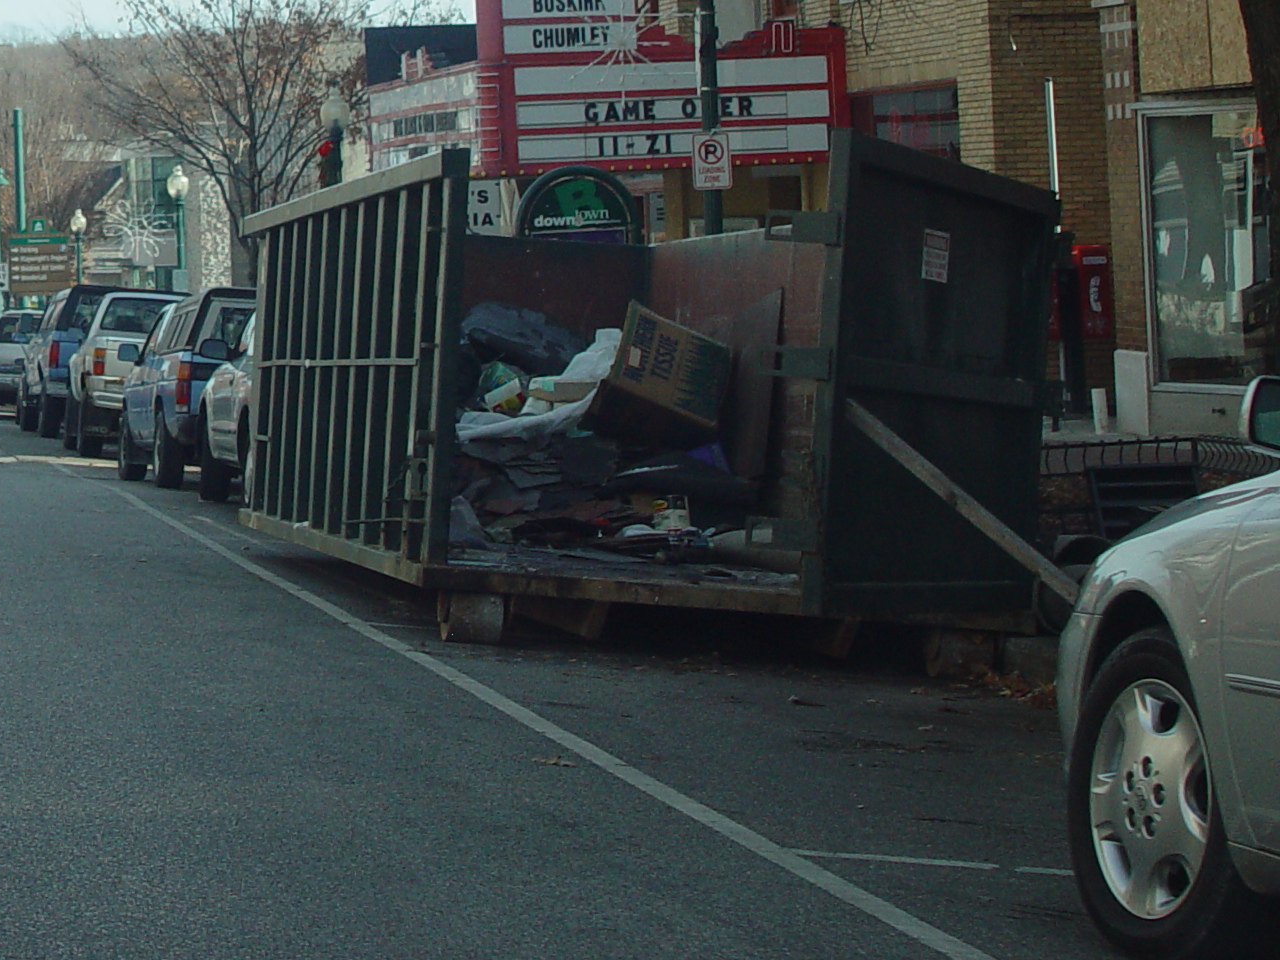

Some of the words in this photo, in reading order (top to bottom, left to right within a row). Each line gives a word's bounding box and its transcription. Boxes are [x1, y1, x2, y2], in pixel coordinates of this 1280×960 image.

[532, 25, 610, 49] CHUMLEY
[584, 100, 656, 123] GAME
[681, 96, 753, 119] OER
[698, 166, 726, 175] LOADING
[703, 175, 721, 183] ZONE
[650, 333, 679, 381] TISSUE
